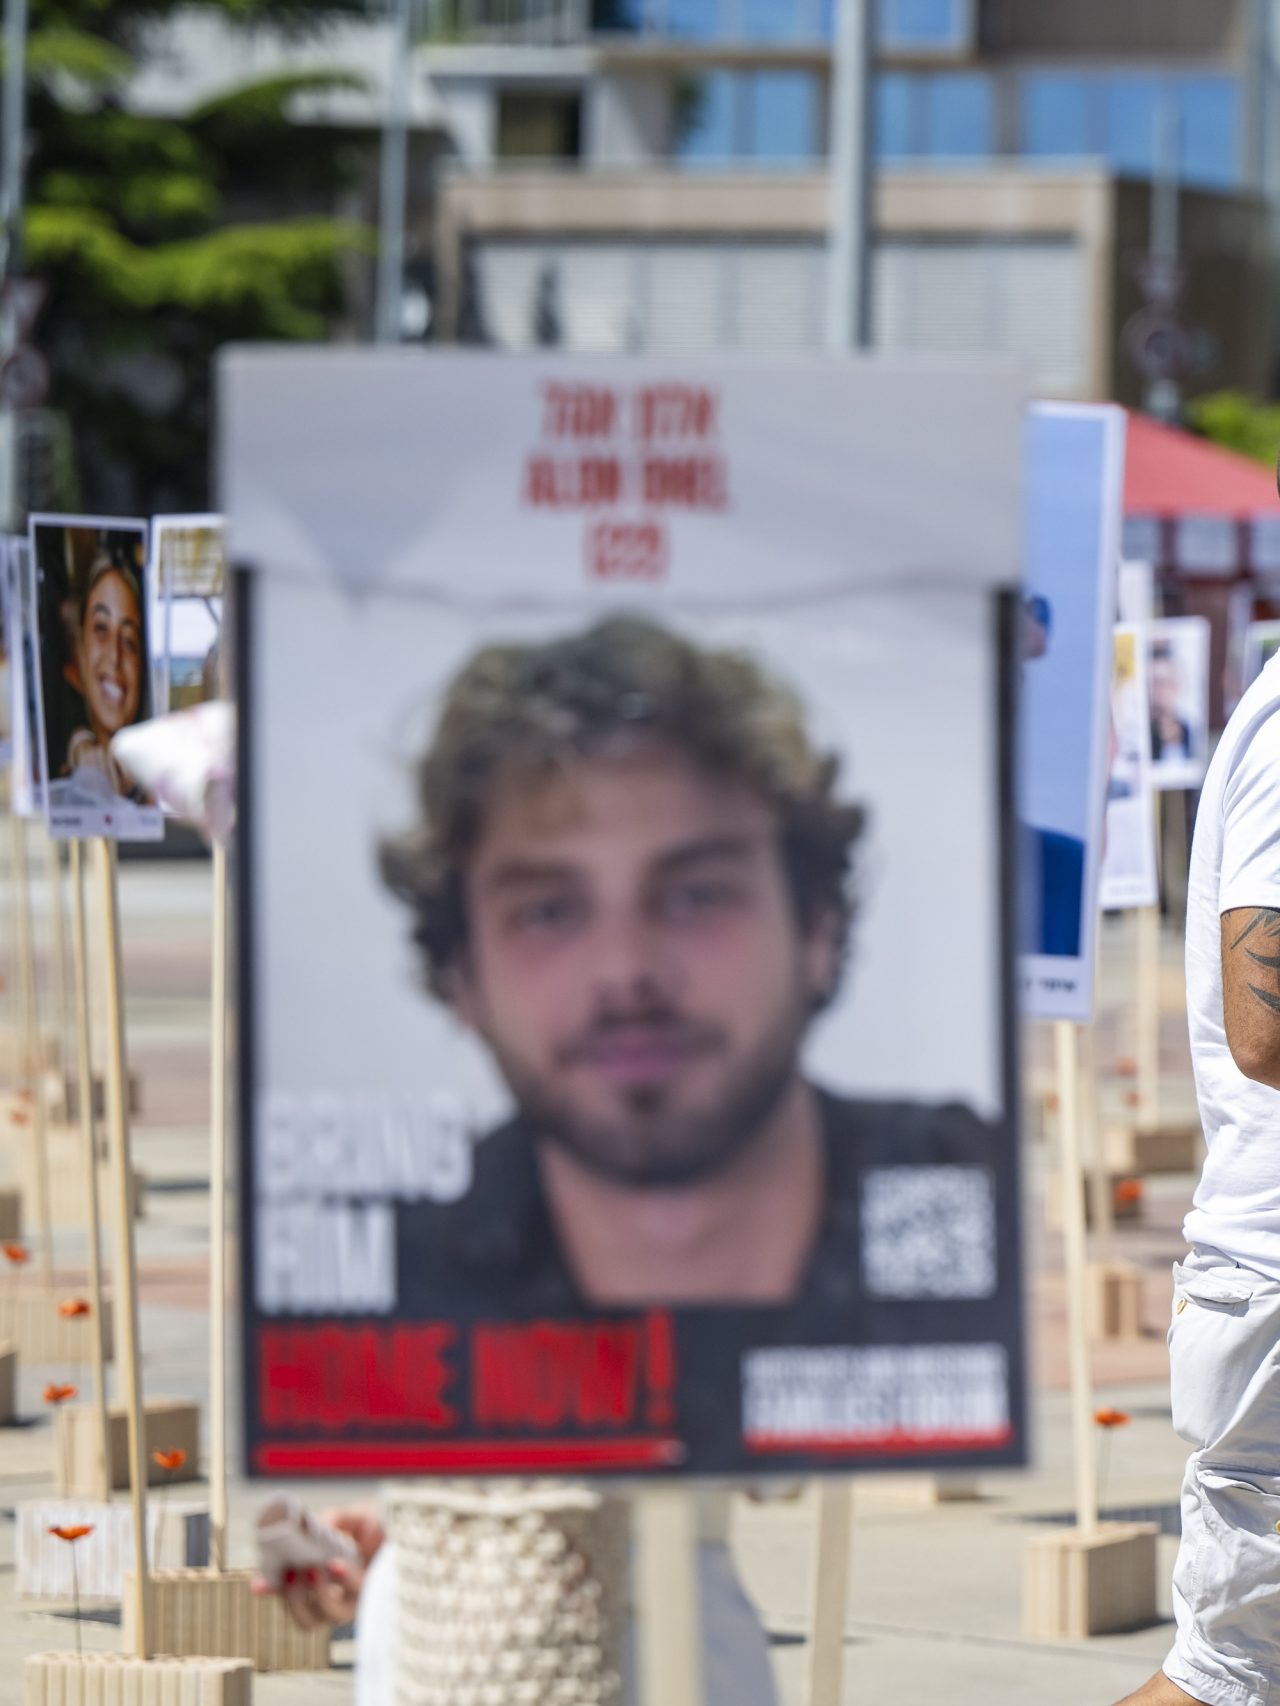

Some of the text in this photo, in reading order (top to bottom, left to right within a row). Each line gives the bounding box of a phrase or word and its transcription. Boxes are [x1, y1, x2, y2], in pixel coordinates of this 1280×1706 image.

[258, 1095, 469, 1199] BRING
[259, 1205, 393, 1311] HIM
[260, 1323, 456, 1427] HOME
[474, 1308, 671, 1426] NOW!
